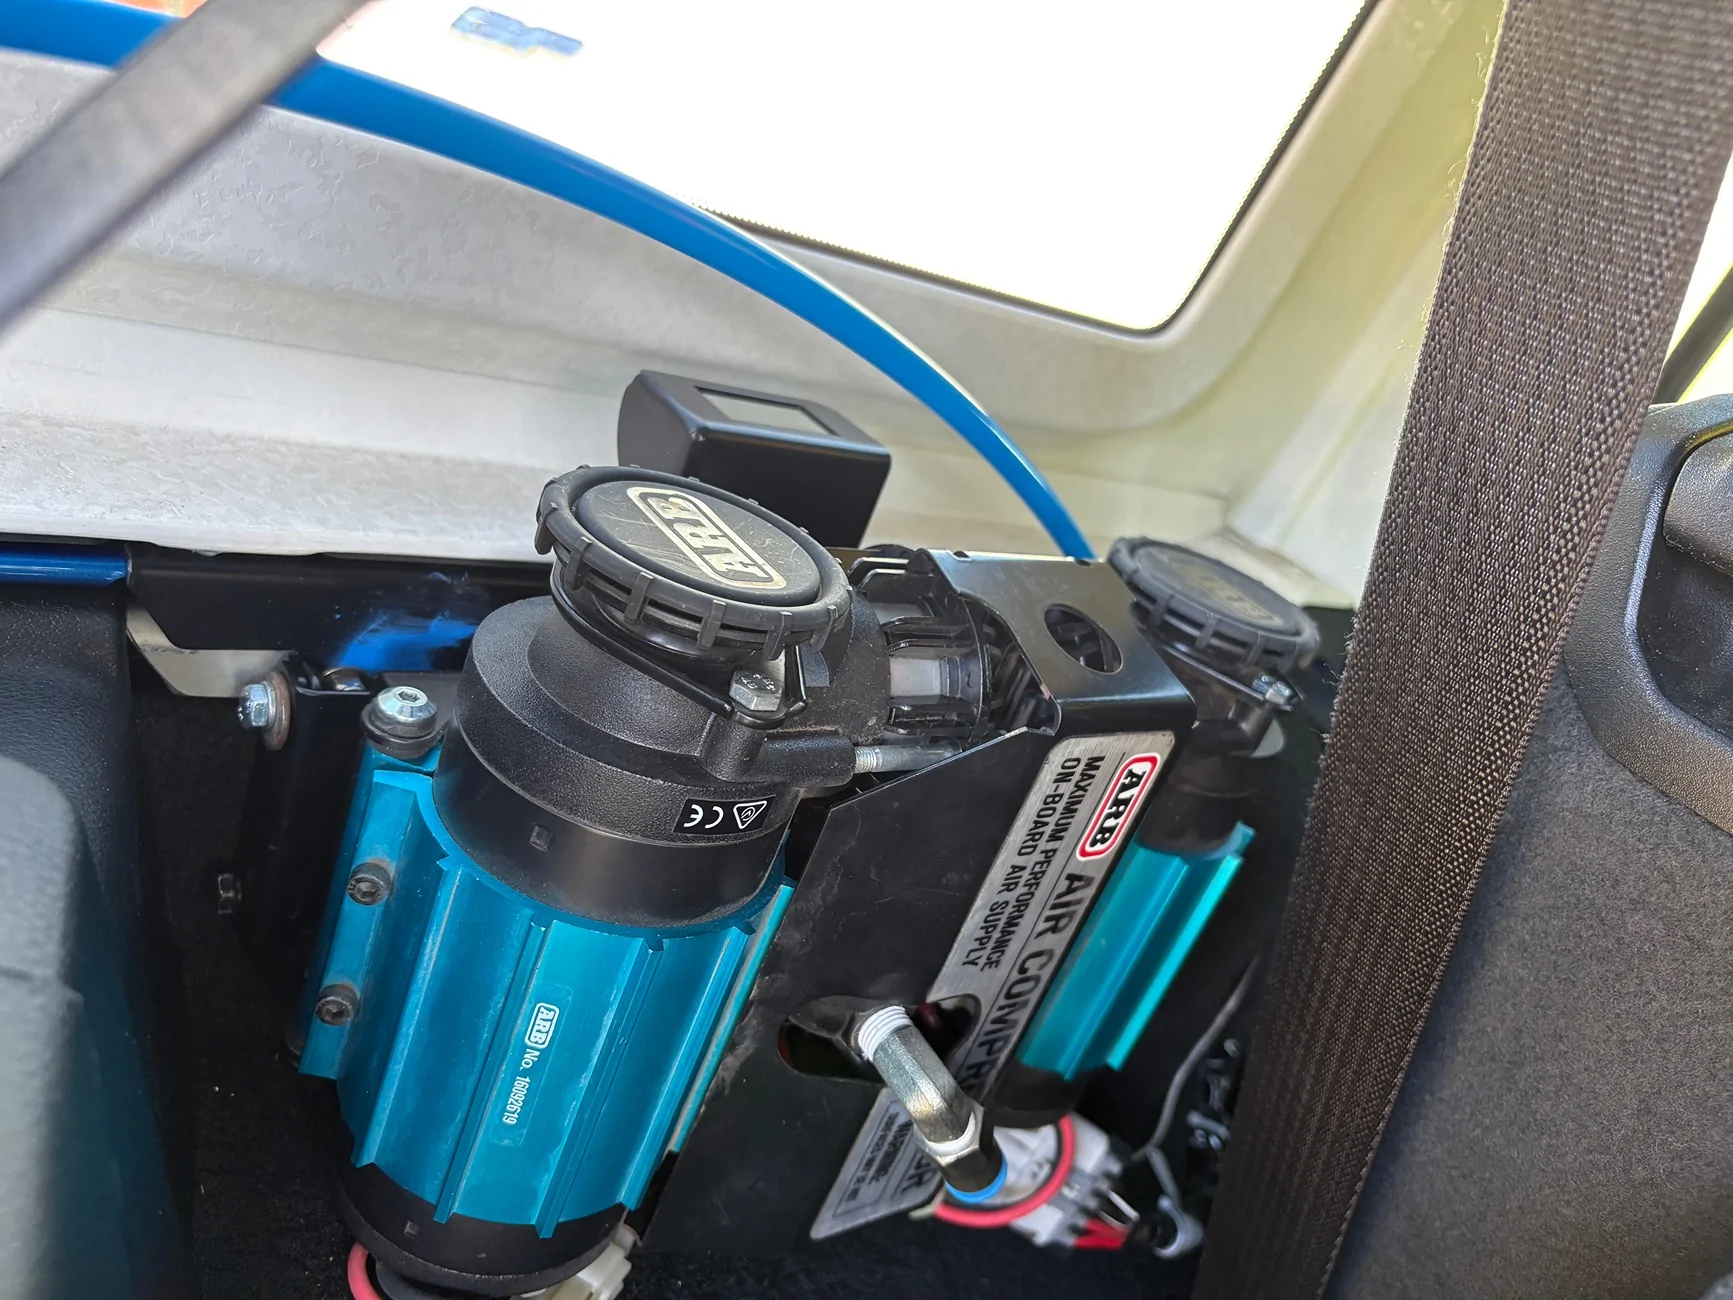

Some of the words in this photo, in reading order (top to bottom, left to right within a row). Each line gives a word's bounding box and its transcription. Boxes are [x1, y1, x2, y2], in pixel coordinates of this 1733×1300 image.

[647, 496, 769, 578] ARB
[1016, 757, 1082, 857] ON-BOARD
[1045, 755, 1106, 844] MAXIMUM
[1089, 768, 1147, 849] ARB
[980, 849, 1056, 973] PERFORMANCE
[996, 864, 1027, 895] AIR
[1034, 872, 1097, 939] AIR
[962, 900, 1010, 967] SUPPLY
[529, 1005, 555, 1045] ARB
